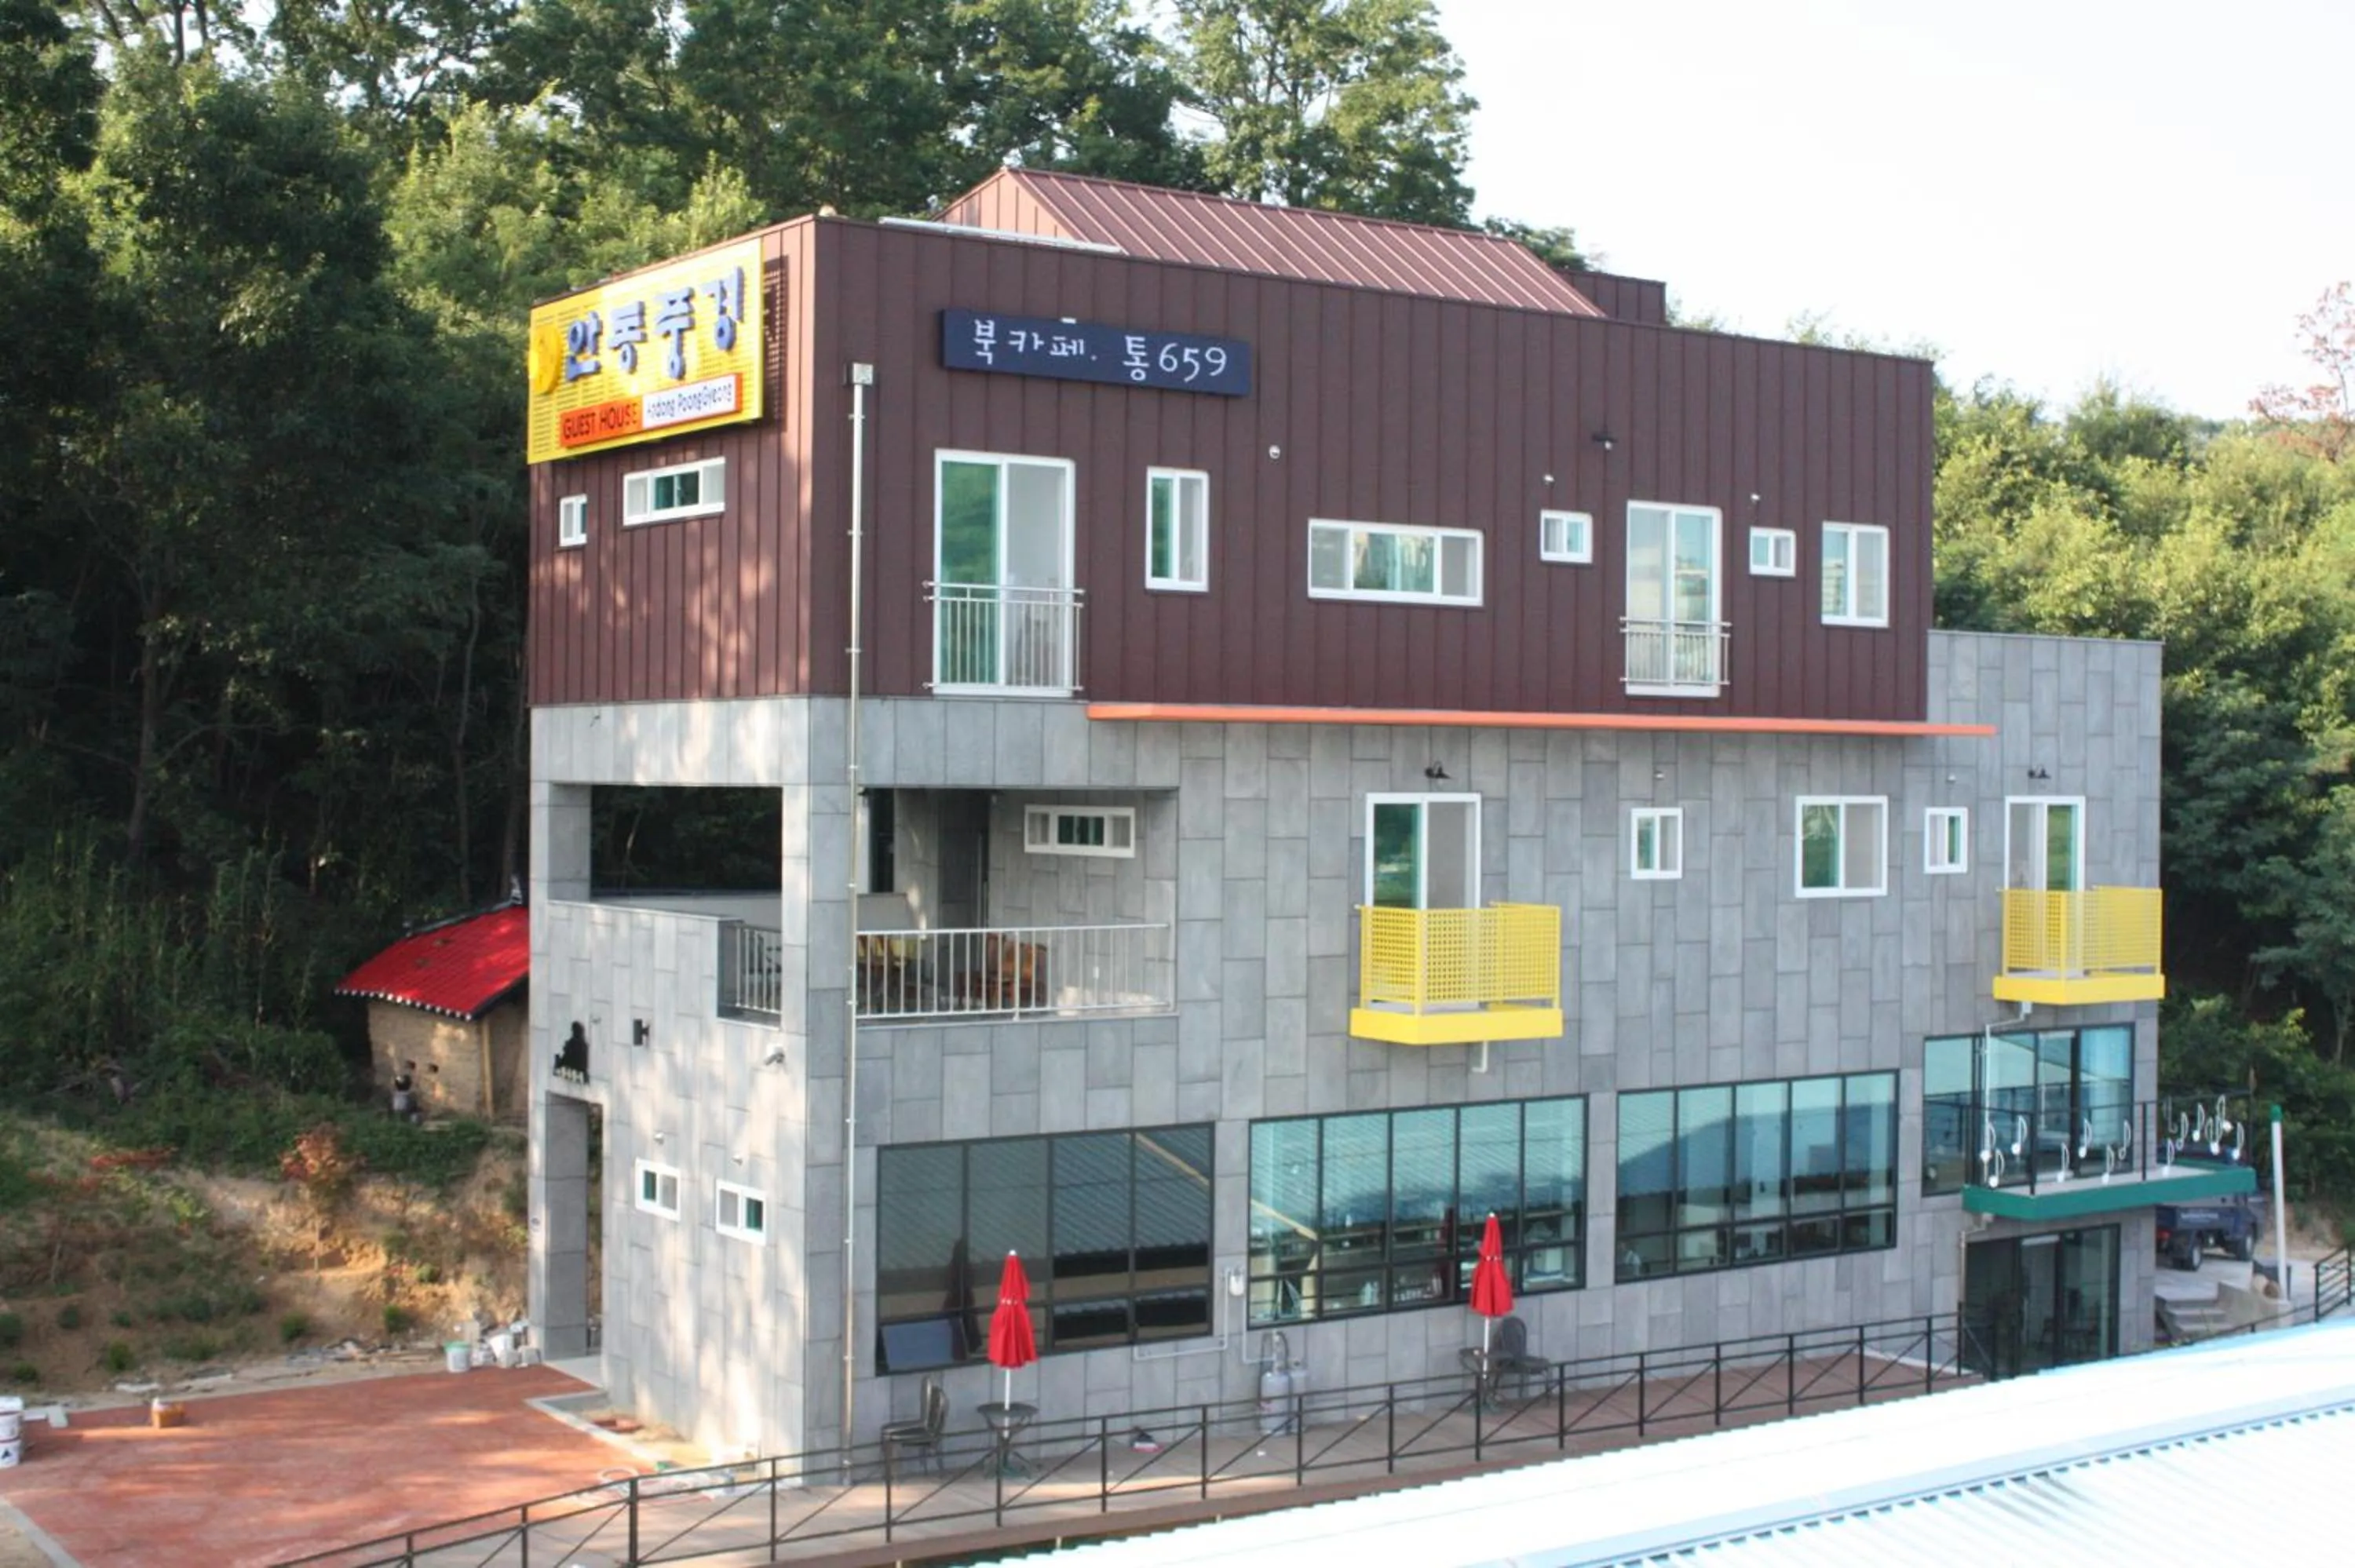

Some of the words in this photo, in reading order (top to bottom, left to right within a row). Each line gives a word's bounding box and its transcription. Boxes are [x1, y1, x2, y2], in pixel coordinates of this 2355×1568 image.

[564, 265, 744, 382] 안동풍경
[563, 411, 596, 439] GUEST
[599, 403, 637, 431] HOUSE
